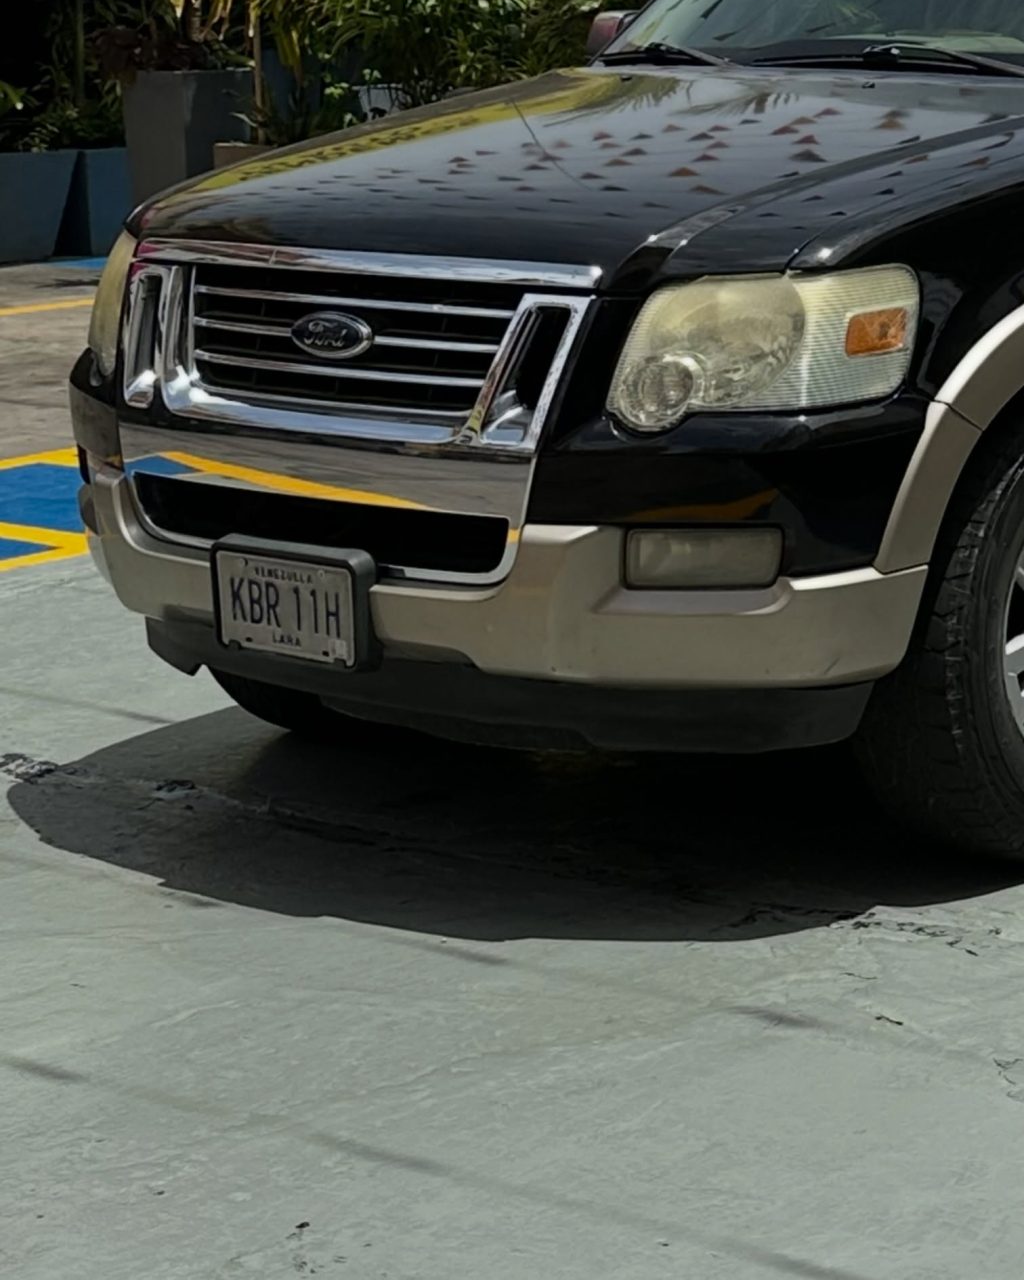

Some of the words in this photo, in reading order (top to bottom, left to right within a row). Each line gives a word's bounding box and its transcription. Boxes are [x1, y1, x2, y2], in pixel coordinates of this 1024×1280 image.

[302, 319, 349, 348] Ford
[230, 577, 281, 629] KBR
[293, 587, 341, 639] 11H
